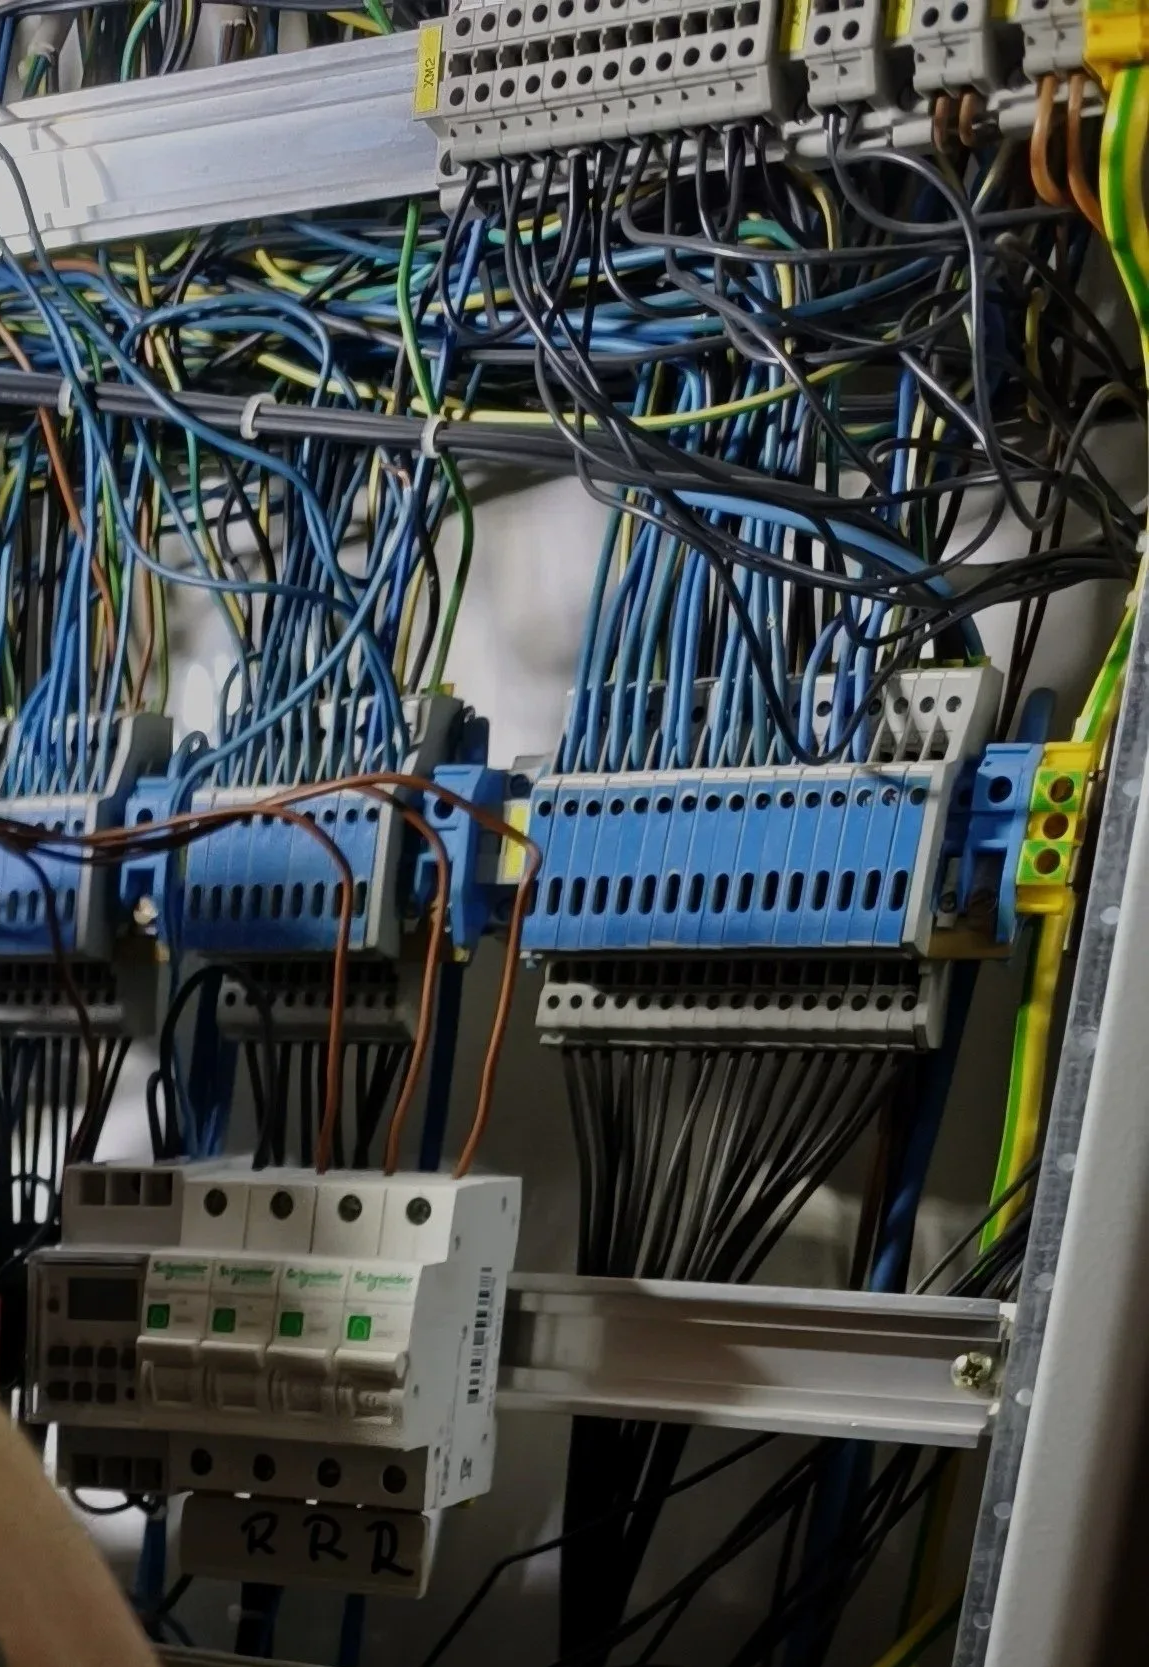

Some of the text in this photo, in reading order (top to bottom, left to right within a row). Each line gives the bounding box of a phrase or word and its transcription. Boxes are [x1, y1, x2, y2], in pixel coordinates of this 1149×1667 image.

[423, 57, 436, 89] XM2
[241, 1511, 278, 1555] R
[302, 1513, 348, 1562] R
